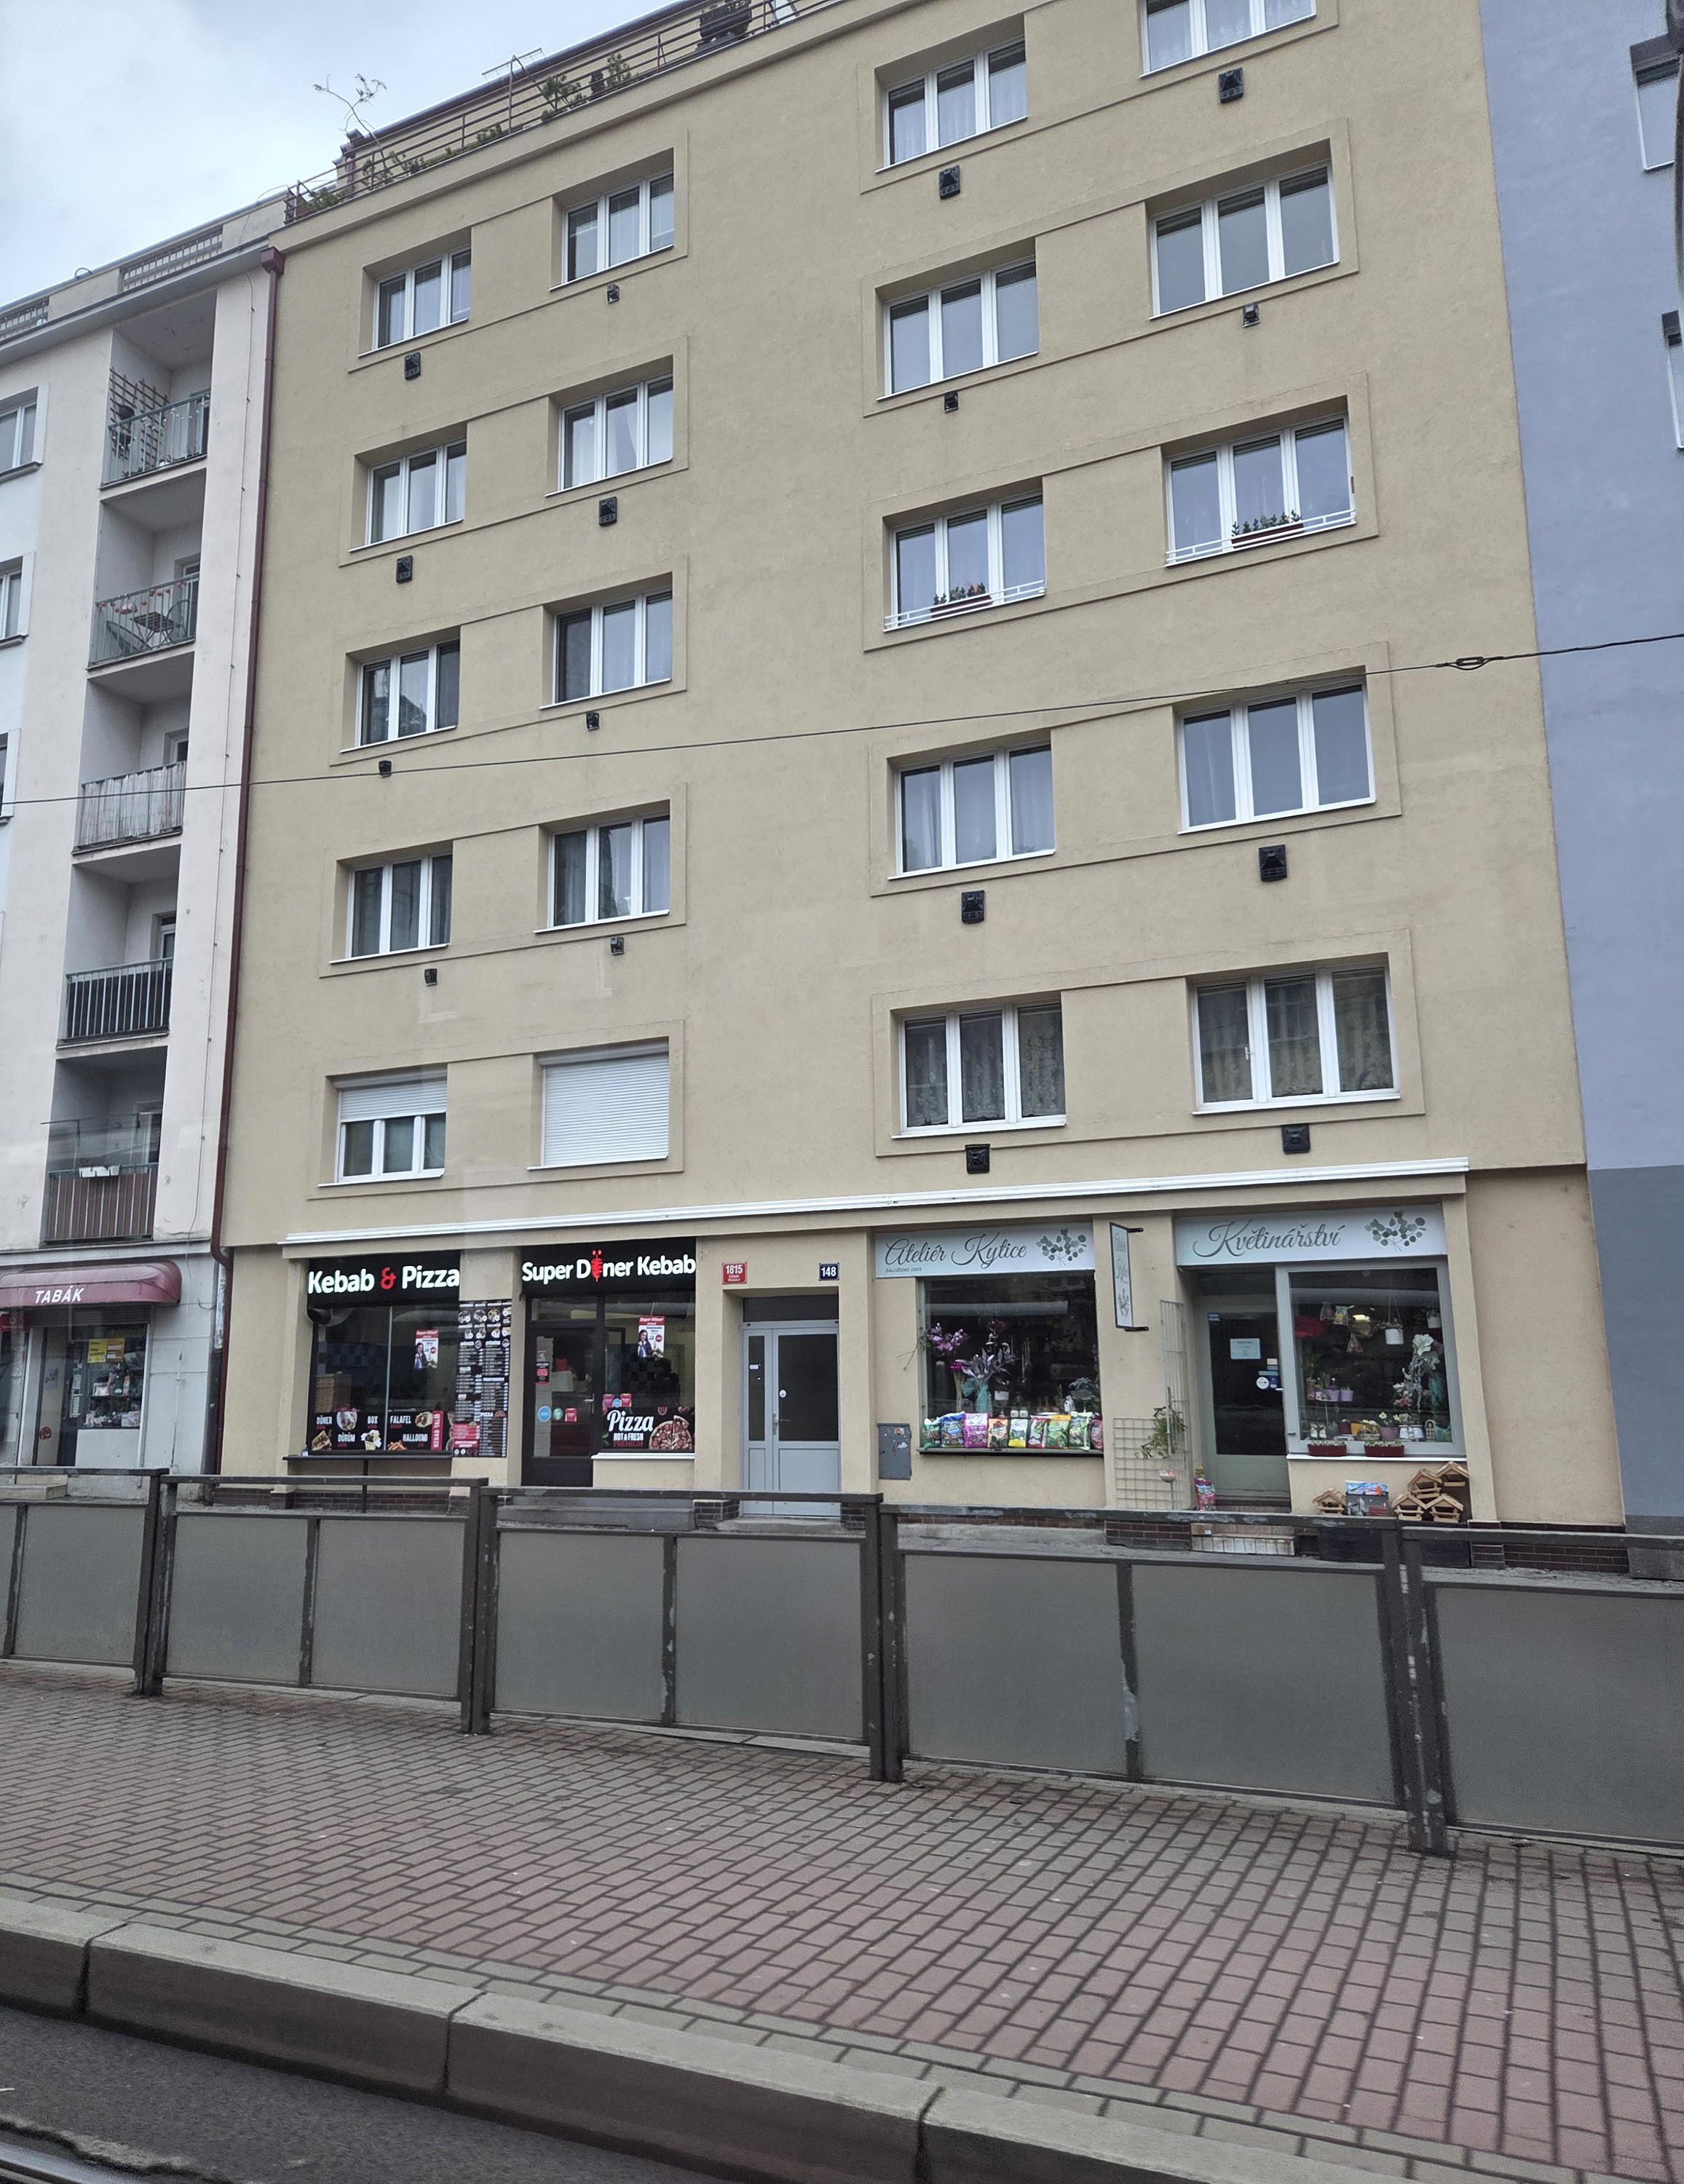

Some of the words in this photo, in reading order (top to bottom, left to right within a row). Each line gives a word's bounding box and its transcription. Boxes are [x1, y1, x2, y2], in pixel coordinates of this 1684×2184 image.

[1193, 1219, 1345, 1258] Květinářství
[885, 1238, 946, 1266] Ateliér
[951, 1232, 1027, 1270] Kytice
[522, 1262, 574, 1285] Super
[637, 1254, 697, 1276] Kebab
[725, 1265, 743, 1275] 1815
[821, 1267, 837, 1277] 148
[308, 1269, 375, 1294] Kebab
[381, 1267, 397, 1290] &
[402, 1265, 460, 1289] Pizza
[35, 1286, 84, 1304] TABÁK
[316, 1415, 333, 1425] DÖNER
[367, 1416, 378, 1424] BOX
[390, 1415, 412, 1424] FALAFEL
[606, 1409, 655, 1432] Pizza
[402, 1433, 428, 1441] HALLOUMI
[614, 1433, 623, 1441] HOT
[628, 1432, 644, 1441] FRESH
